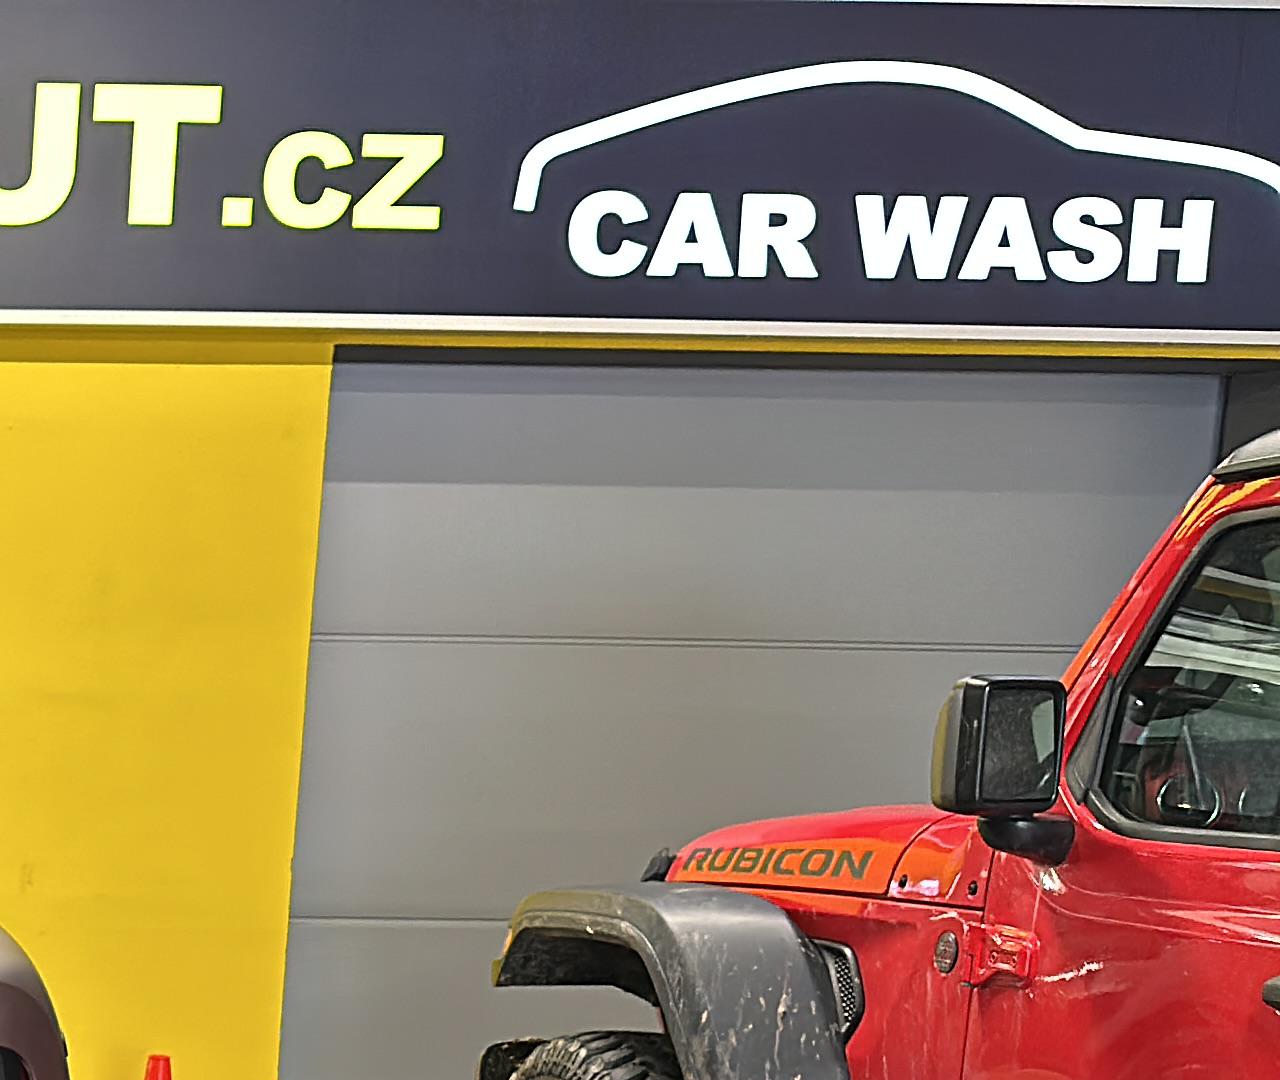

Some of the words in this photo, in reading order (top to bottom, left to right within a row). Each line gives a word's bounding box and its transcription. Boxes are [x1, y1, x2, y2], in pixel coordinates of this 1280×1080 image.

[567, 189, 819, 278] CAR
[854, 194, 1215, 283] WASH
[683, 847, 875, 880] RUBICON
